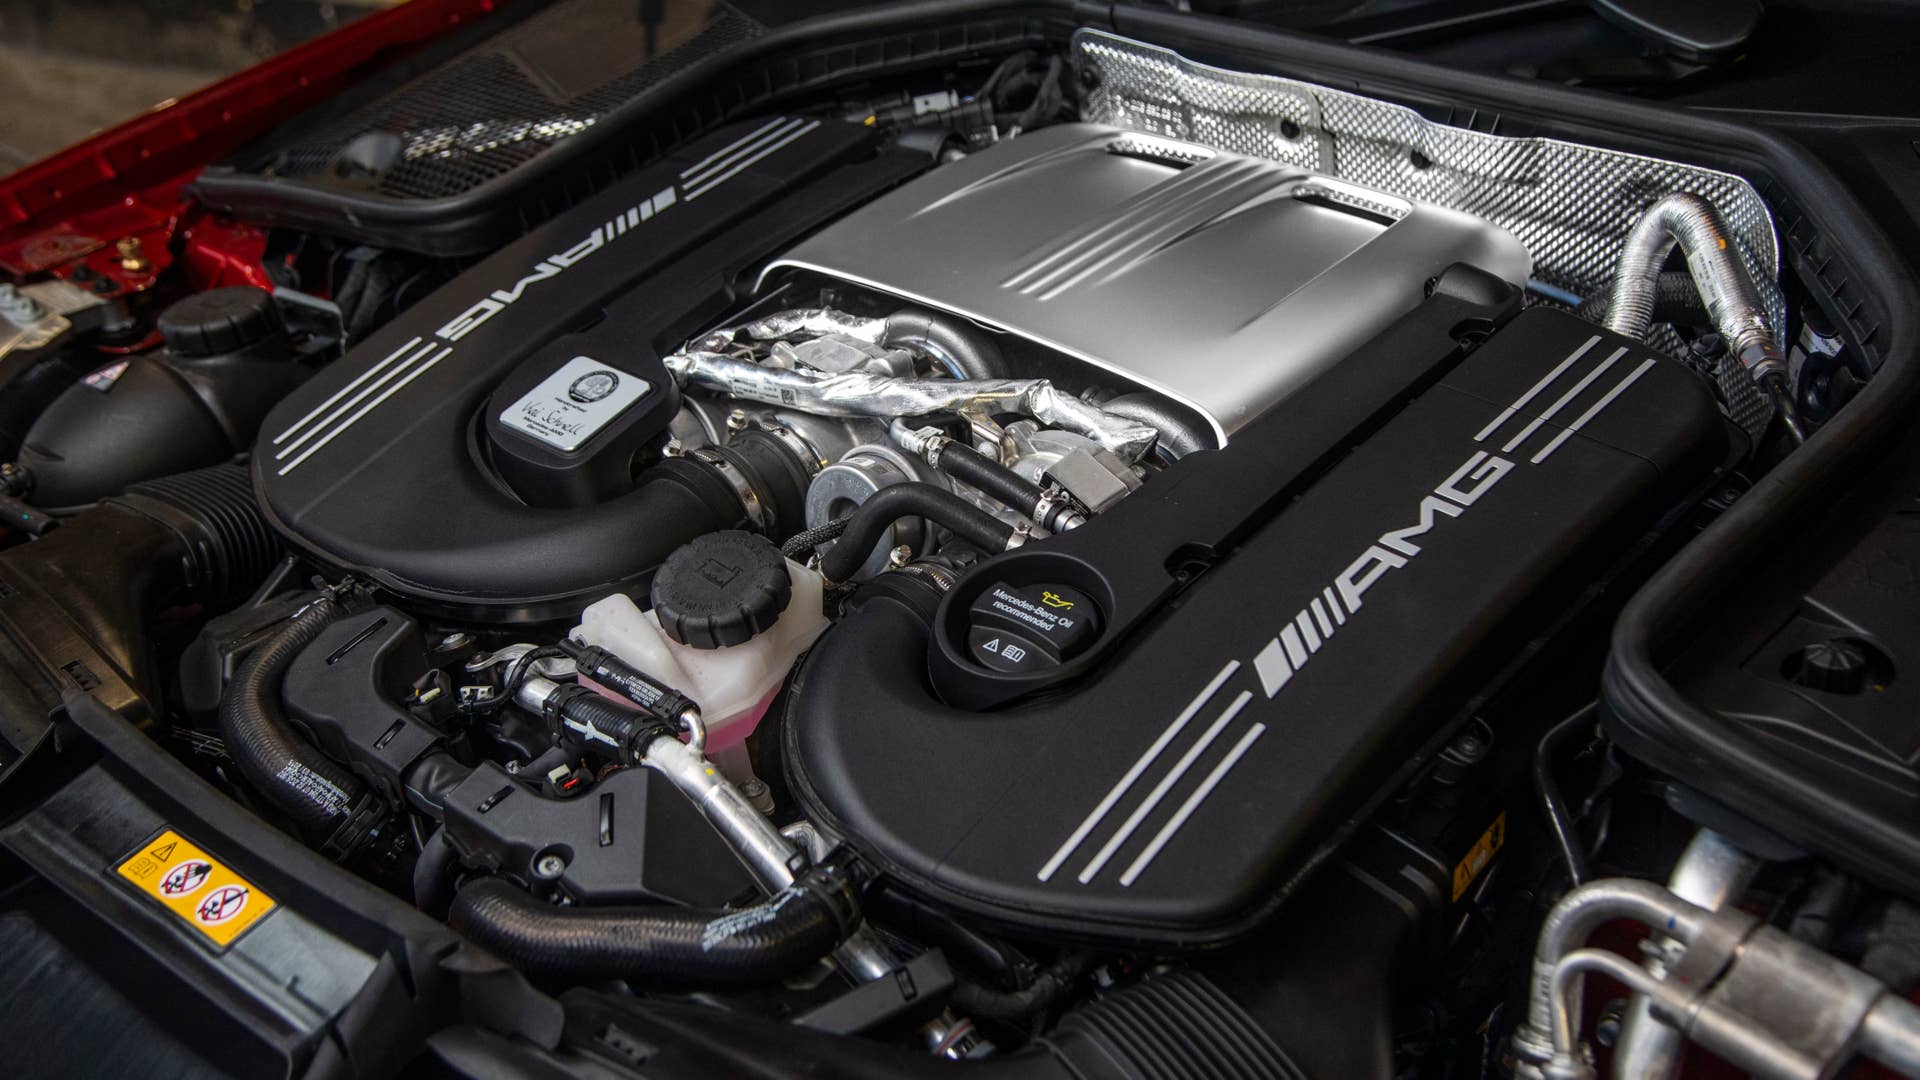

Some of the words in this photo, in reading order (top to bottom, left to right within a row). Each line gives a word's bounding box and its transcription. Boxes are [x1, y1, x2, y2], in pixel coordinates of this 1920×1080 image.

[435, 228, 605, 341] AMG
[1334, 450, 1516, 614] AMG
[992, 588, 1059, 622] Mercedes-Benz
[1058, 617, 1074, 629] Oil
[992, 600, 1055, 631] recommended
